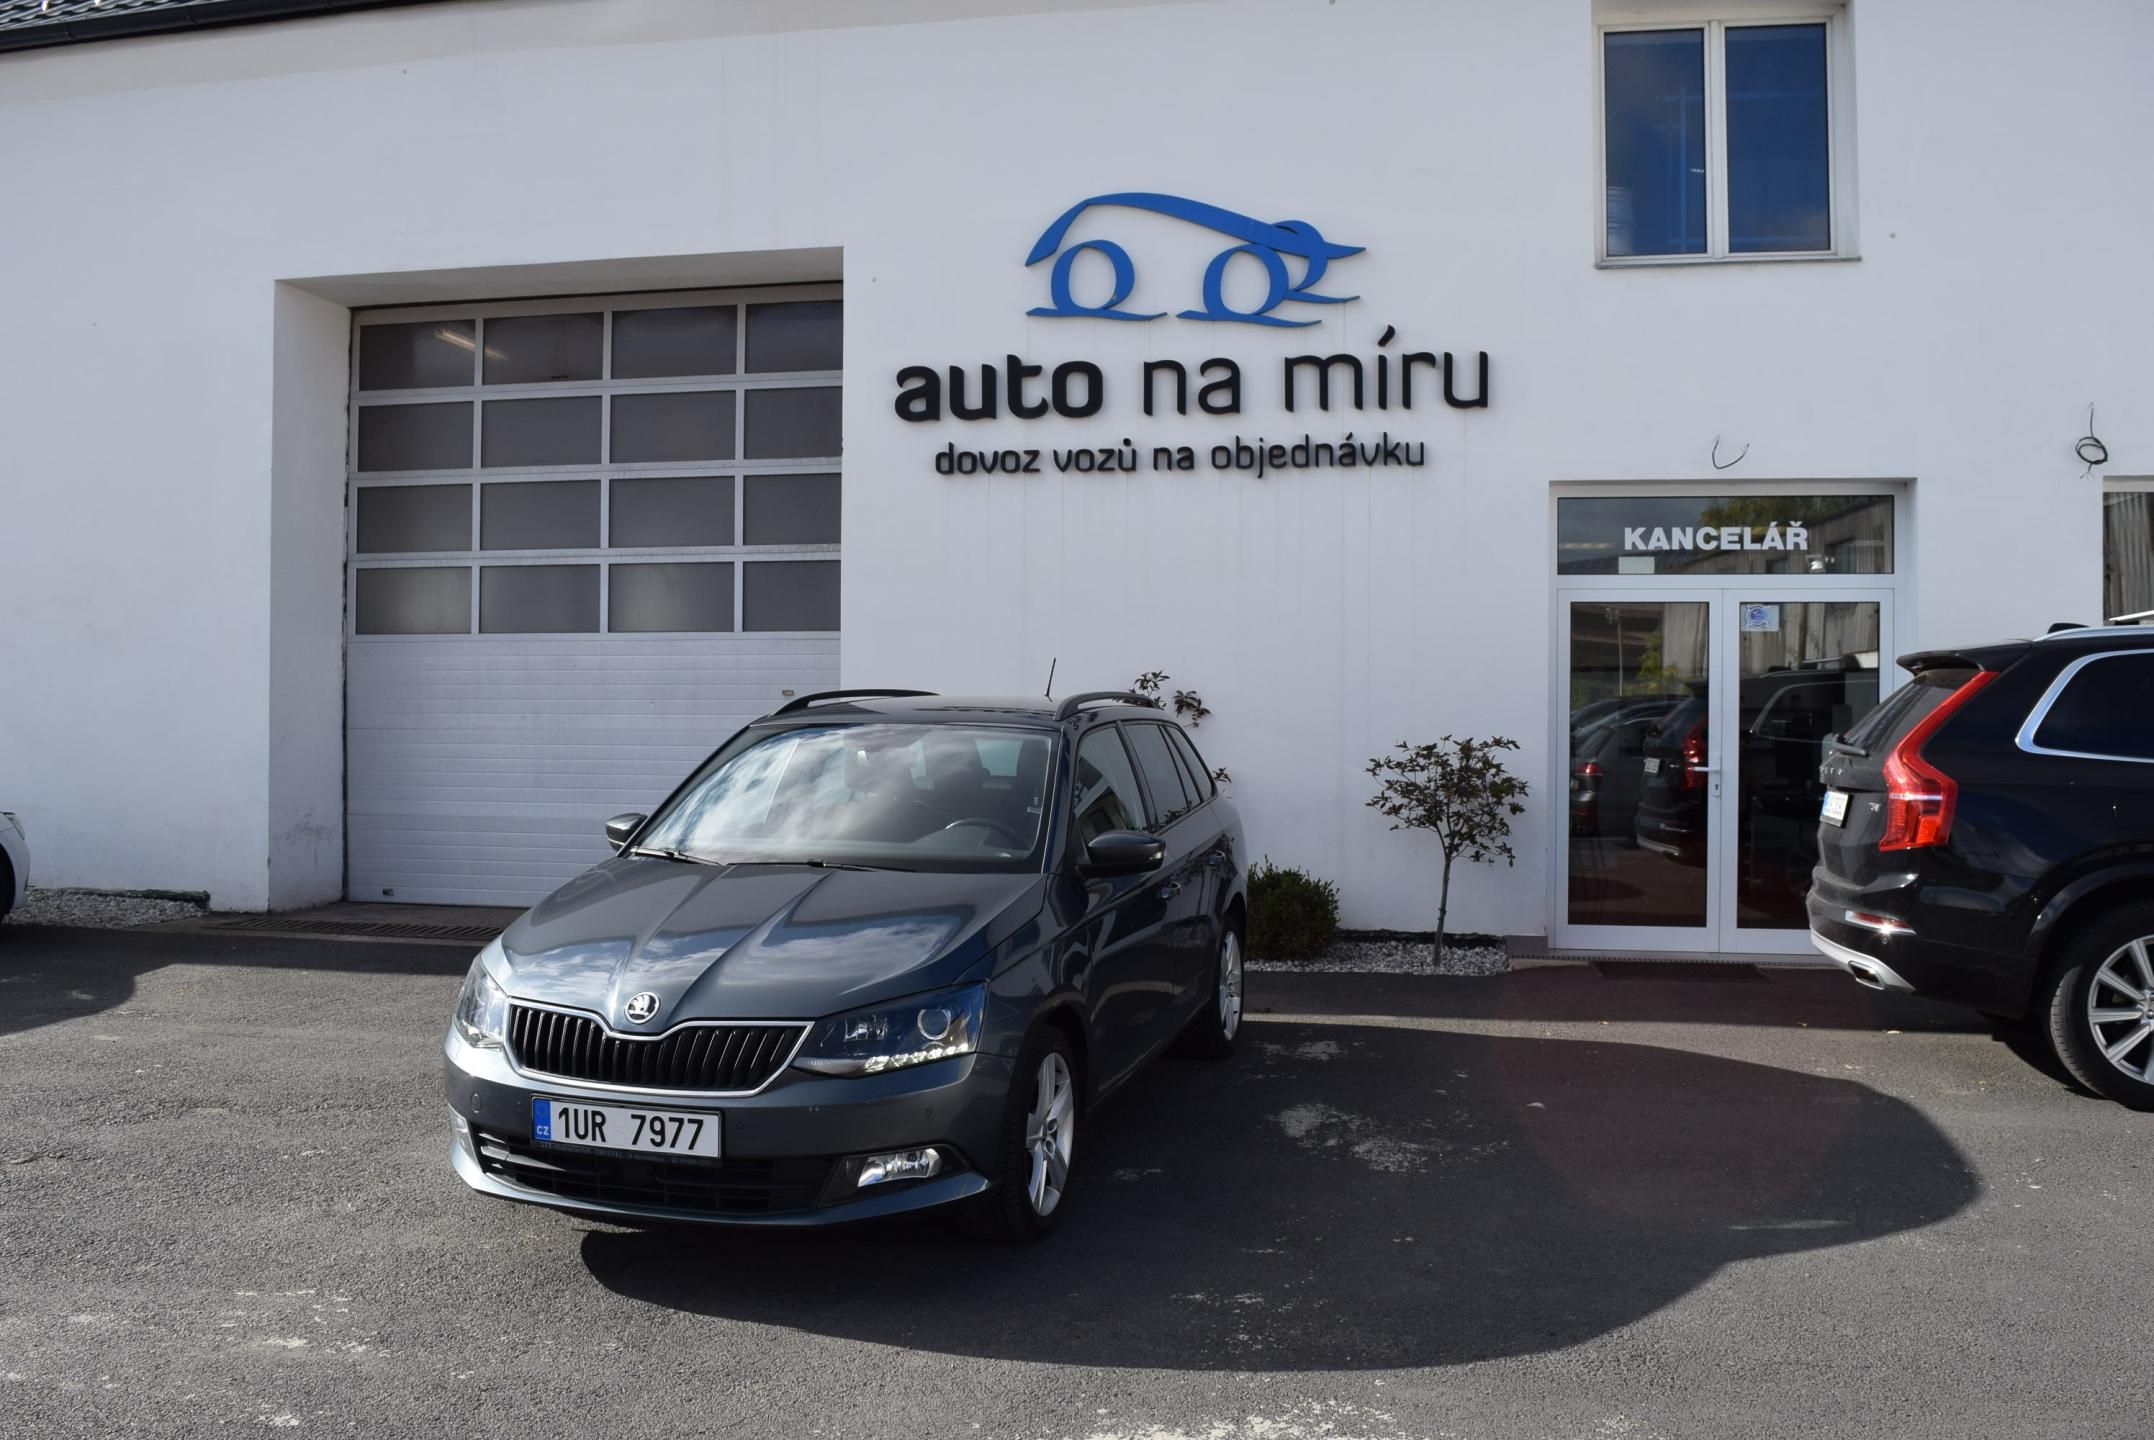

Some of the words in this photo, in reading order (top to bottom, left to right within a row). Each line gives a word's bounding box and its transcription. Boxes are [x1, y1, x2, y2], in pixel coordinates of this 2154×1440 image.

[894, 354, 1104, 424] auto
[1143, 357, 1242, 417] na
[1284, 324, 1489, 413] míru
[934, 441, 1041, 476] dovoz
[1053, 437, 1137, 474] vozů
[1152, 446, 1196, 473] na
[1210, 431, 1425, 480] objednávku
[1624, 520, 1808, 551] KANCELÁŘ
[536, 1125, 550, 1136] CZ
[558, 1107, 607, 1143] 1UR
[630, 1113, 704, 1151] 7977
